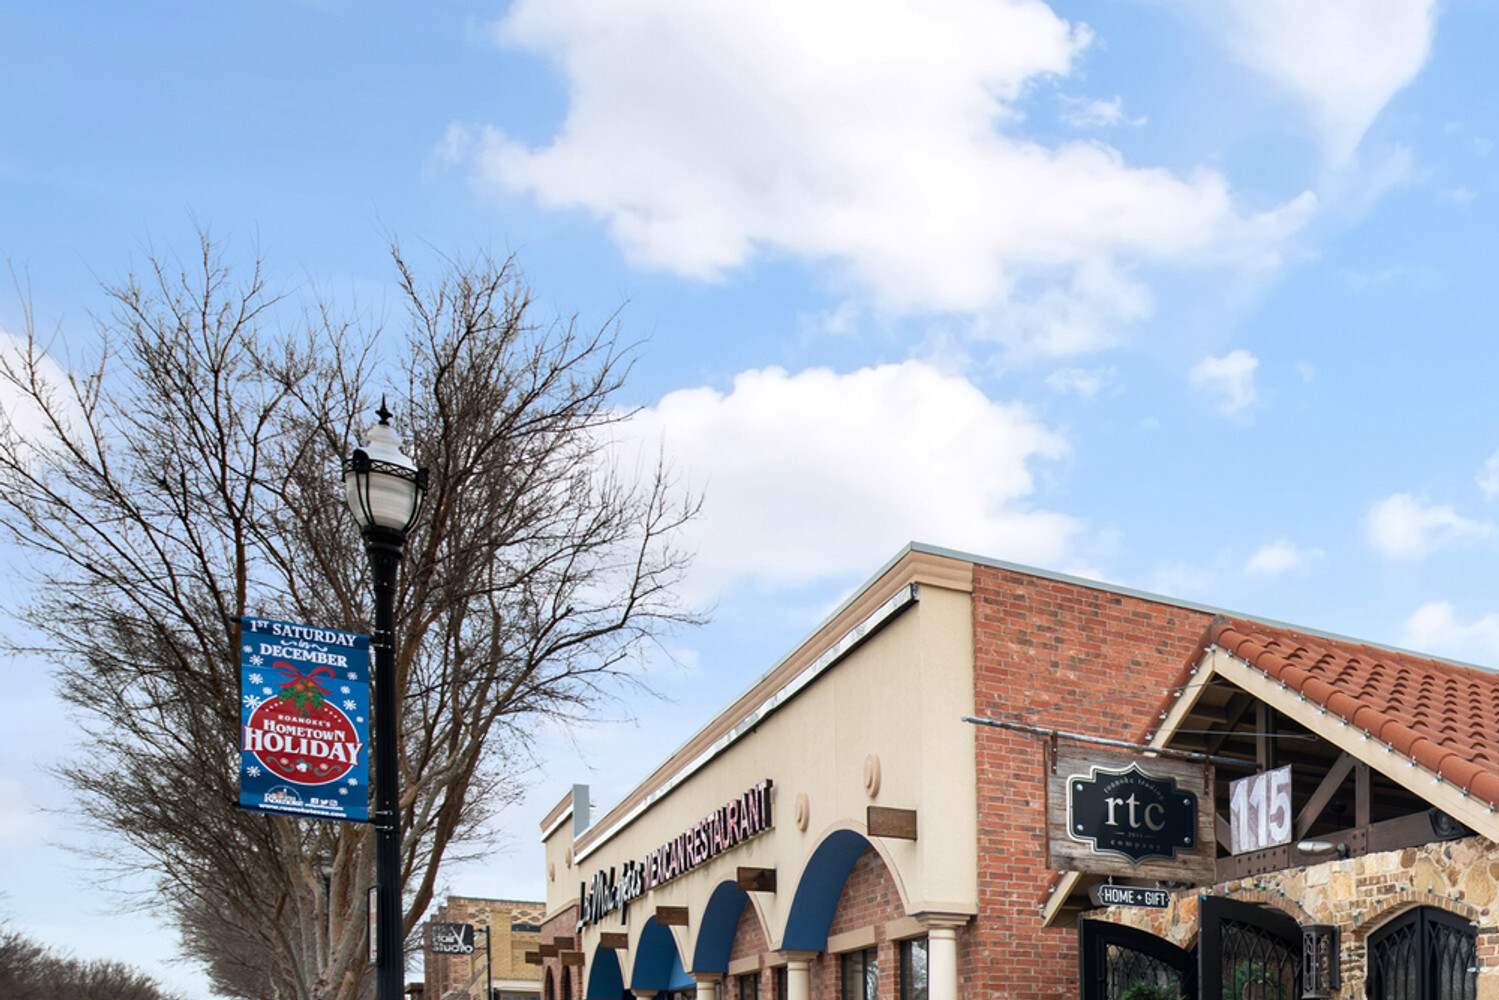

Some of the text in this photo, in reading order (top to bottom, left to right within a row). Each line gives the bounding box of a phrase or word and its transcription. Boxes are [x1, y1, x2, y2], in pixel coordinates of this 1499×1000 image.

[272, 623, 357, 647] SATURDAY
[259, 643, 348, 668] DECEMBER
[263, 719, 345, 742] HOMETOWN
[278, 714, 331, 727] ROANOKE'S
[244, 726, 364, 765] HOLIDAY
[1104, 792, 1166, 832] rtc
[1231, 766, 1292, 852] 115
[643, 836, 689, 890] MEXICAN
[685, 778, 774, 868] RESTAURANT
[1104, 889, 1134, 904] HOME
[1144, 891, 1166, 906] GIFT
